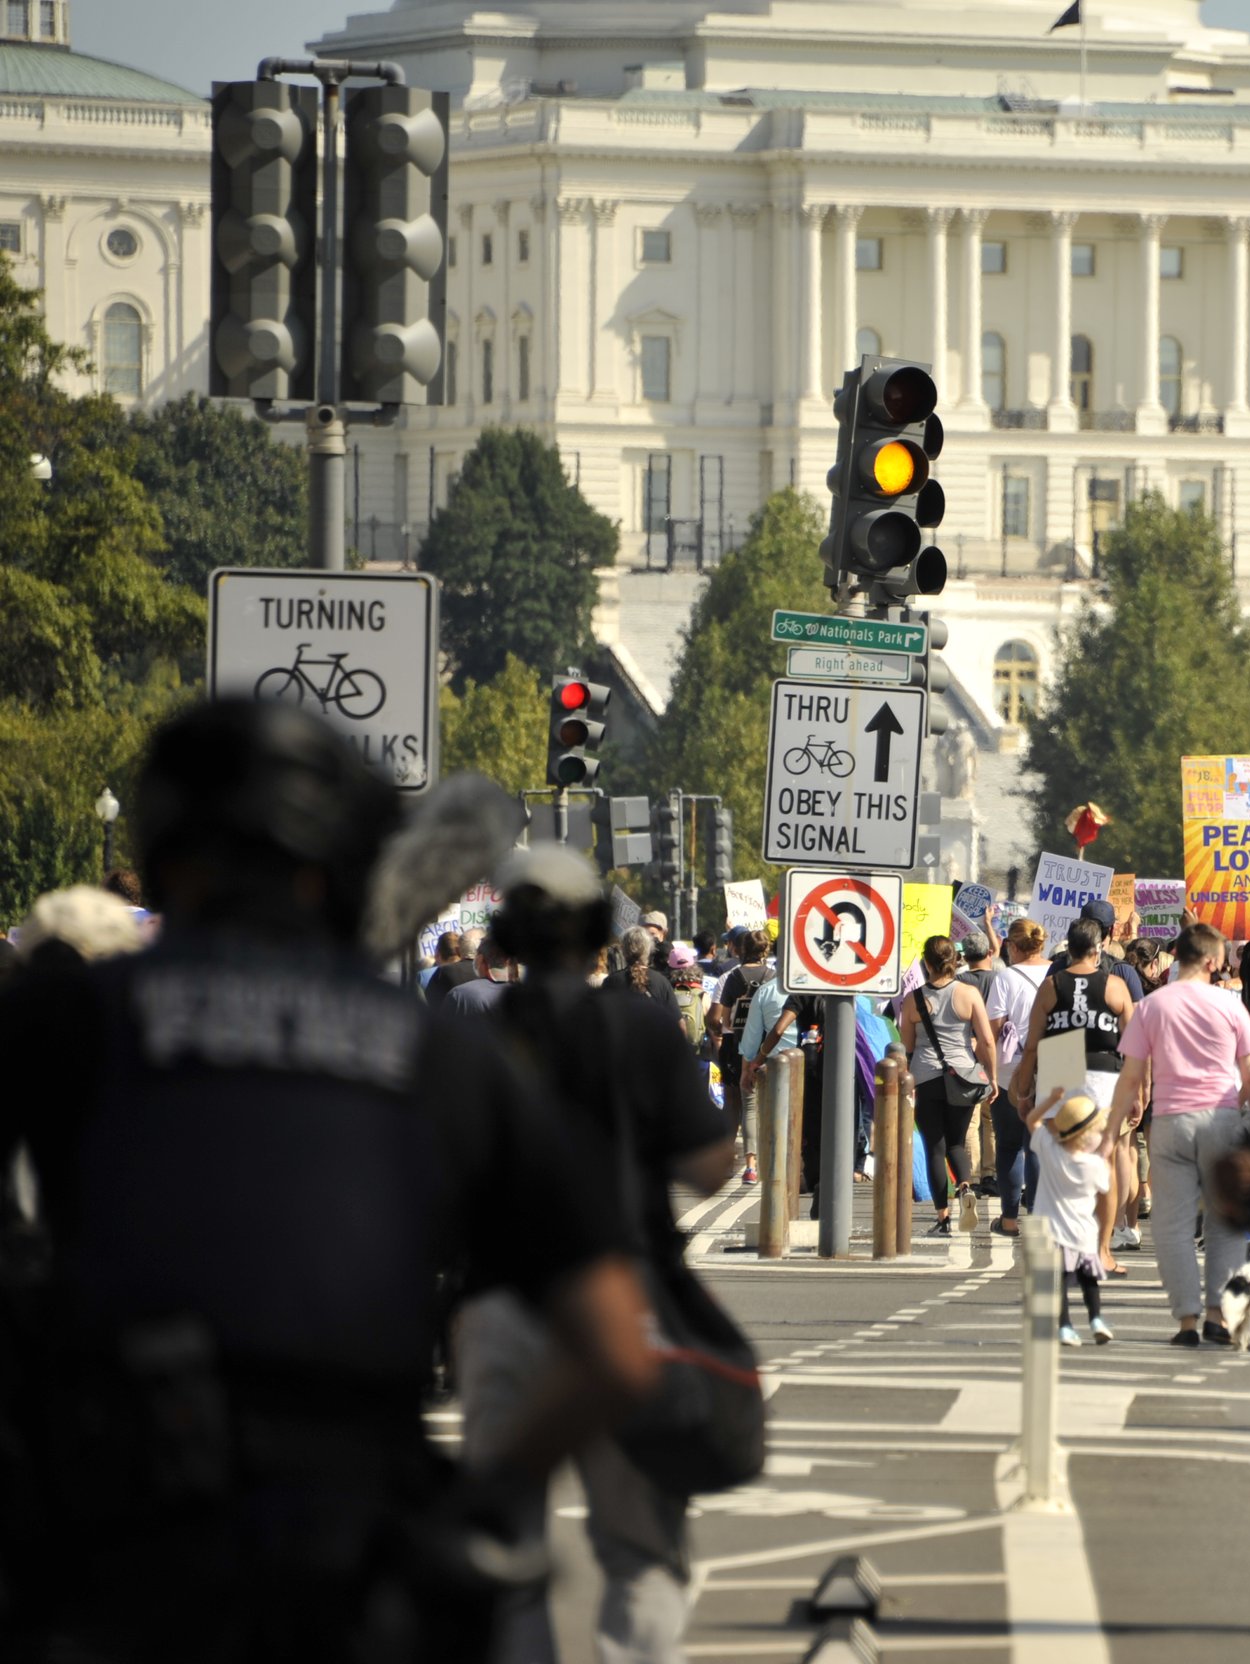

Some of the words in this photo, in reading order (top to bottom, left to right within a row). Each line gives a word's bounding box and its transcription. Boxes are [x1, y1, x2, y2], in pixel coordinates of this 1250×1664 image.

[259, 597, 386, 632] TURNING
[820, 624, 873, 642] Nationals
[878, 630, 903, 645] Park
[815, 657, 844, 672] Right
[849, 658, 883, 672] ahead
[784, 693, 850, 724] THRU
[778, 787, 842, 817] OBEY
[853, 792, 908, 822] THIS
[776, 822, 866, 854] SIGNAL
[1044, 860, 1106, 888] TRUST
[1135, 889, 1180, 907] UNLESS
